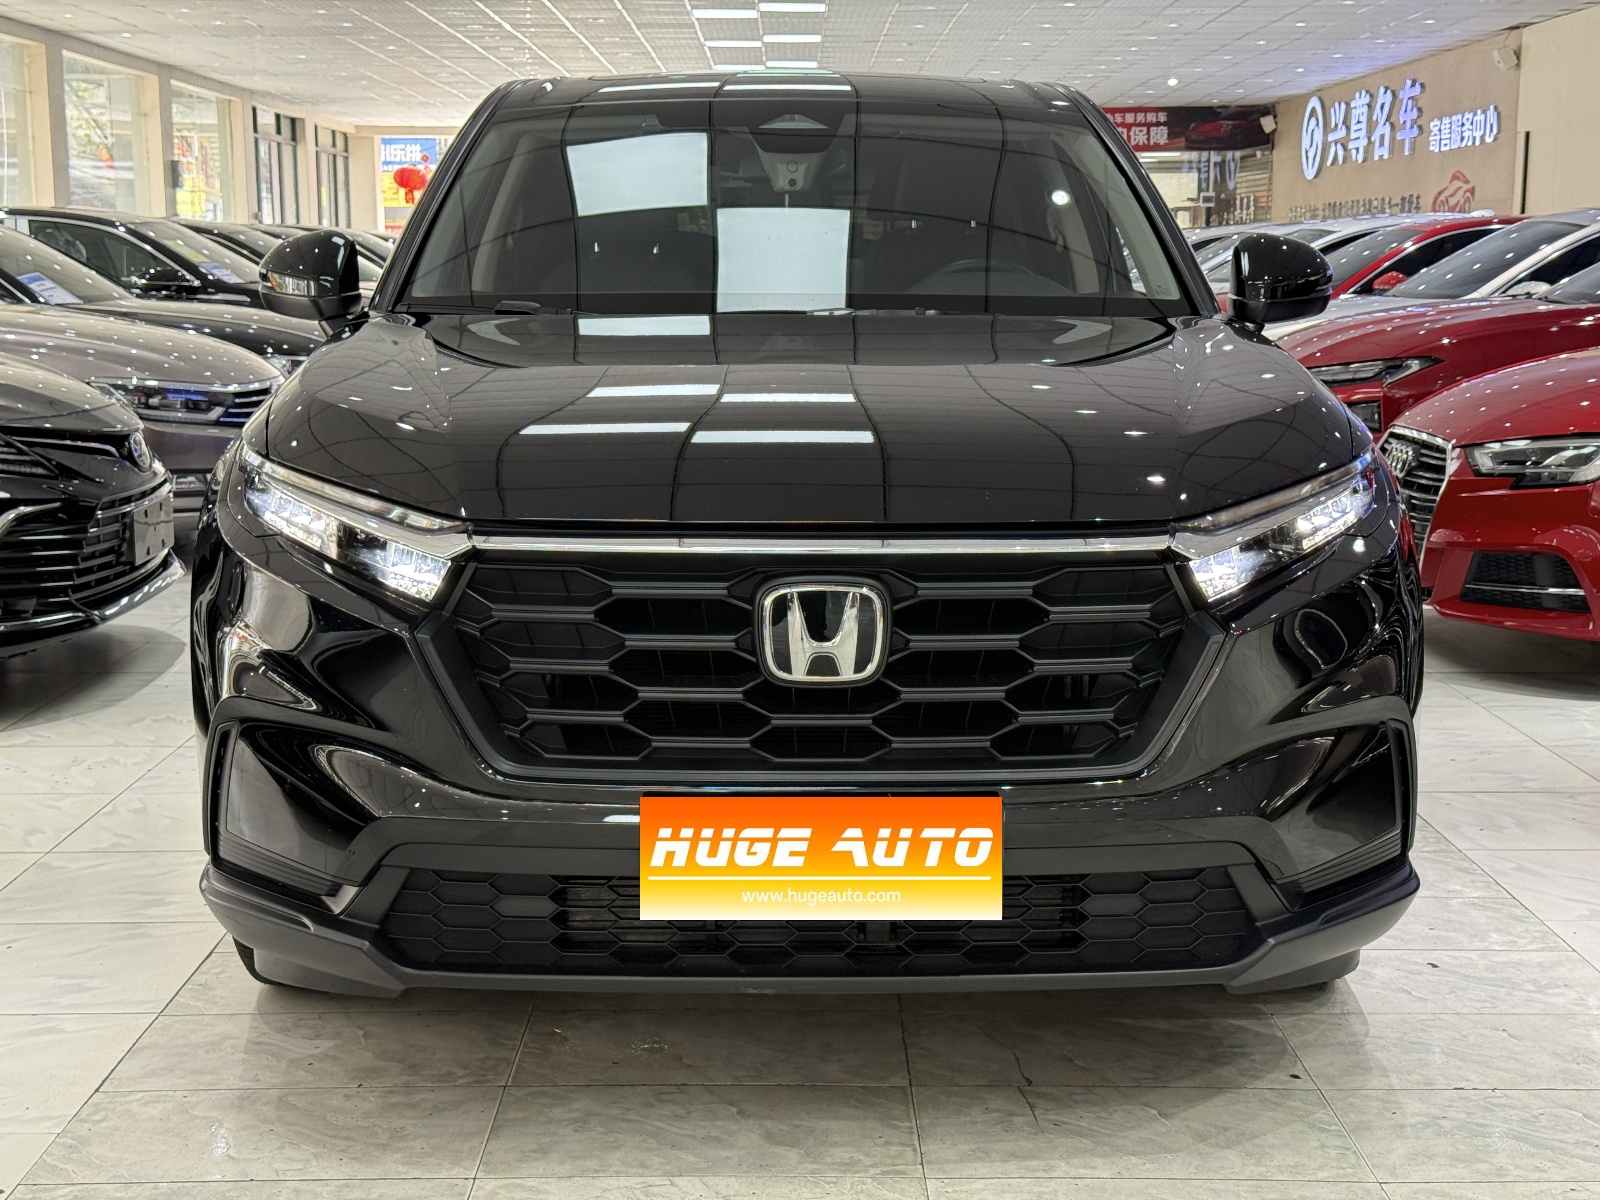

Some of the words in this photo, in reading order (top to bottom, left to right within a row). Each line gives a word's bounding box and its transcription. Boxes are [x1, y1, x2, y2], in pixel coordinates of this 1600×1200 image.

[1326, 77, 1422, 167] 兴尊名车
[1429, 104, 1499, 153] 寄售服务中心
